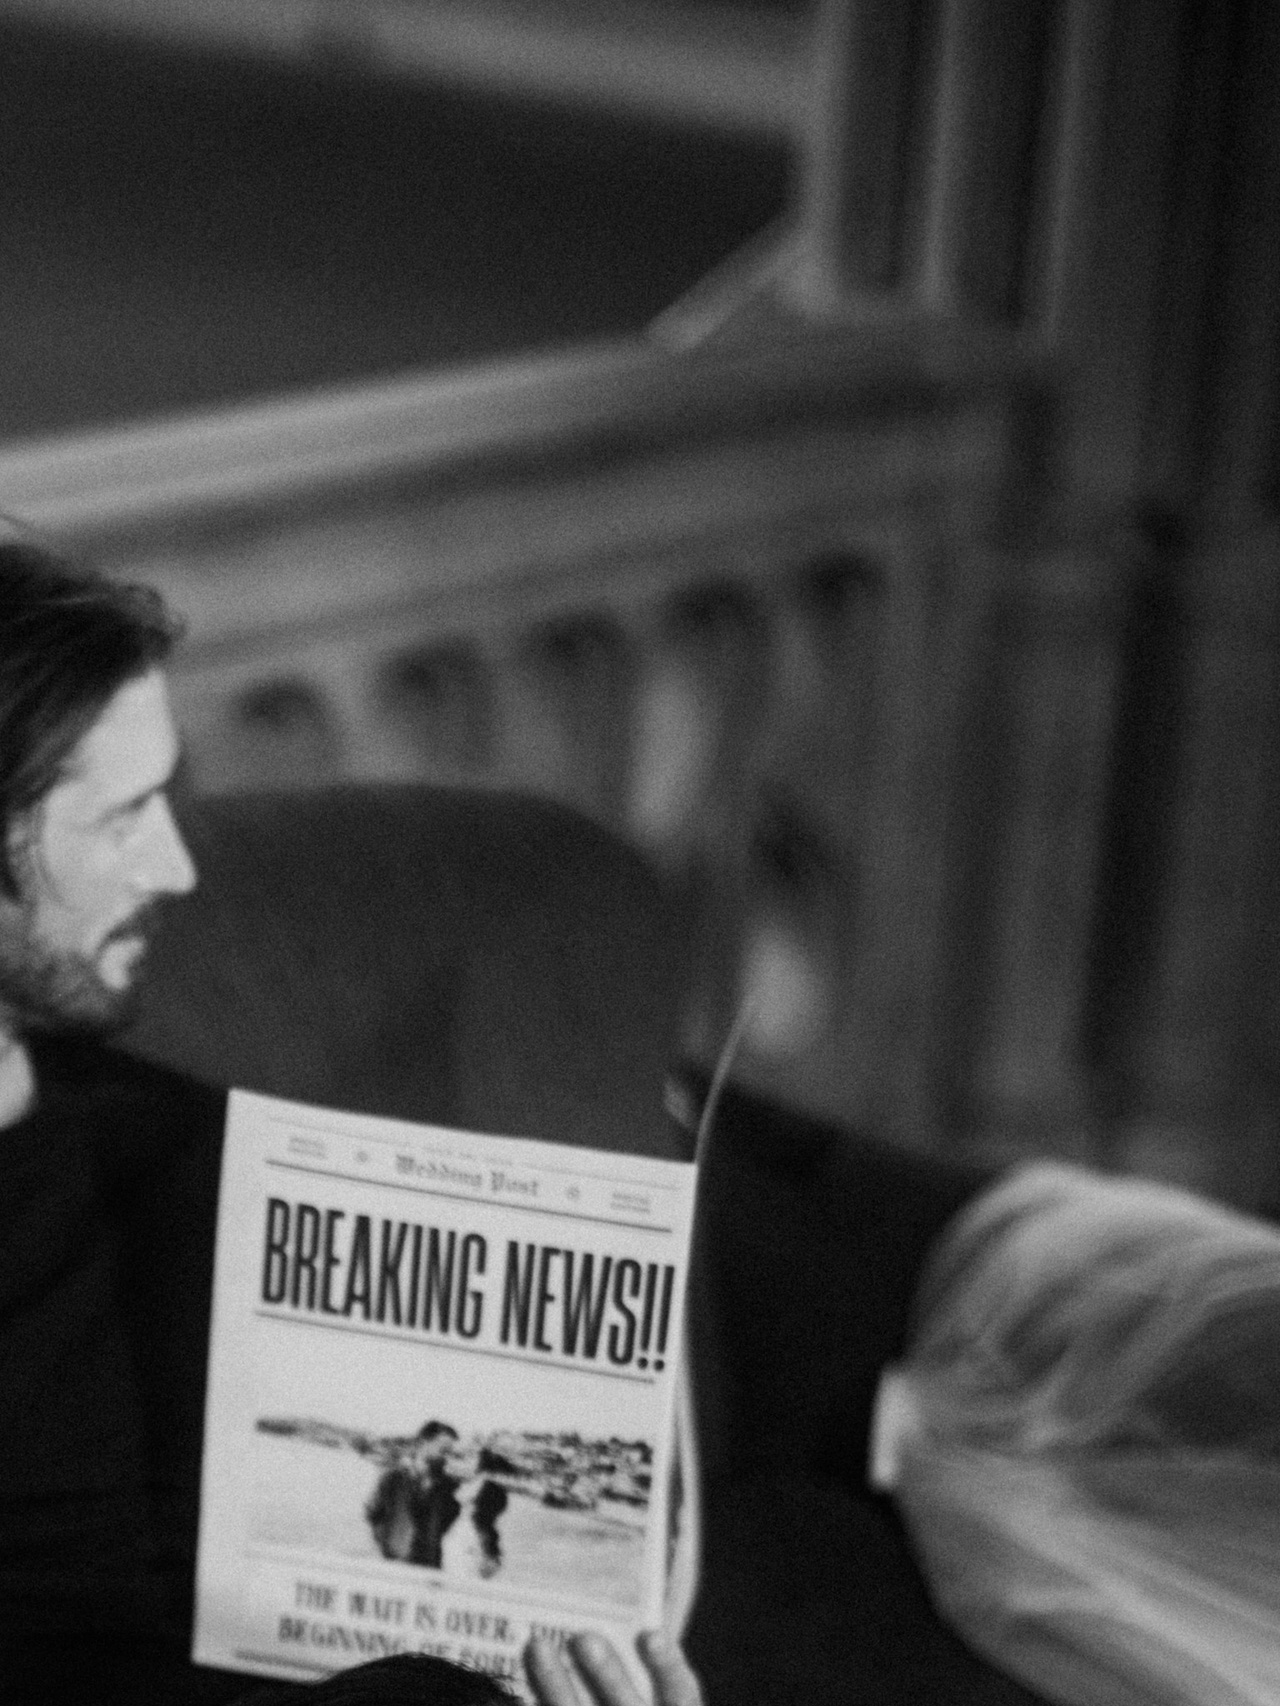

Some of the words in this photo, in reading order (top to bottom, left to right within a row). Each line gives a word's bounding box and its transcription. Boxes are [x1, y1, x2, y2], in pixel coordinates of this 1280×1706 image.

[261, 1197, 488, 1340] BREAKING
[499, 1240, 676, 1372] NEWS!!
[294, 1581, 338, 1610] THE
[348, 1591, 407, 1625] WAIT
[414, 1603, 438, 1630] IS
